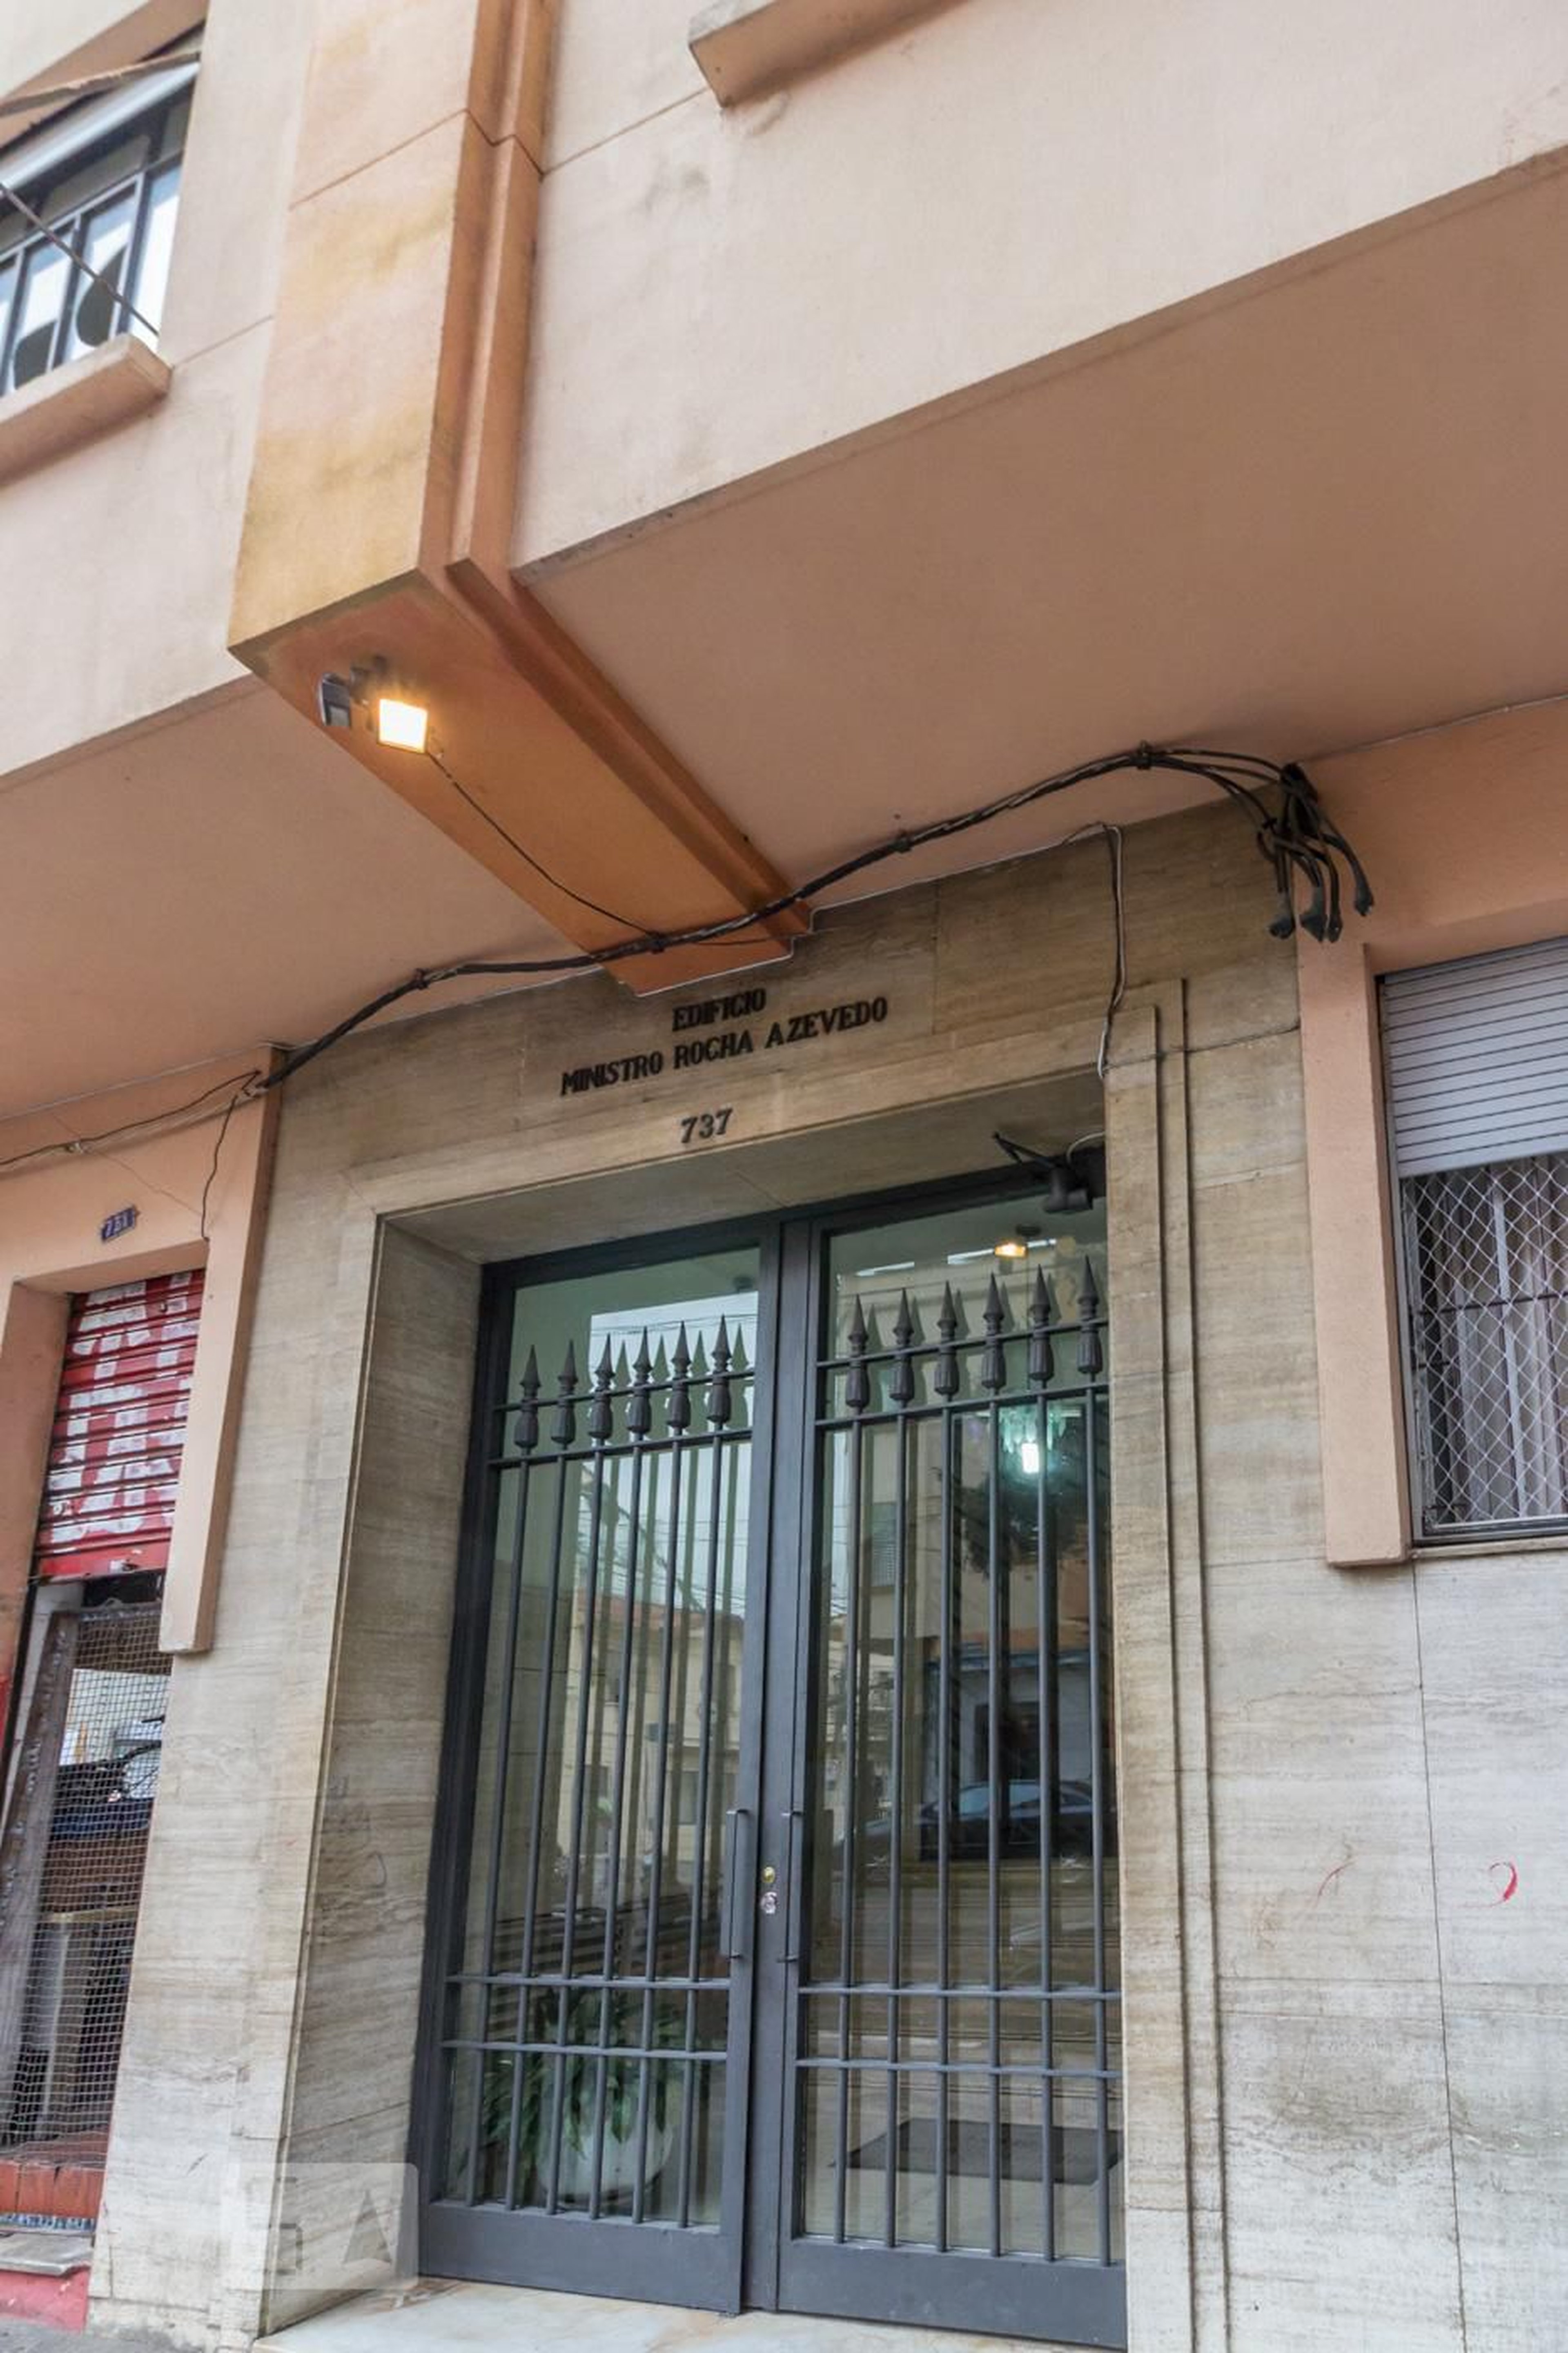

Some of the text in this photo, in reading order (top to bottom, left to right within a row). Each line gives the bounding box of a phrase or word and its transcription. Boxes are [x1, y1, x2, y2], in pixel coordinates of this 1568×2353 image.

[672, 988, 766, 1032] EDIFICIO
[560, 996, 888, 1096] MINISTRO ROCHA AZEVEDO
[681, 1108, 733, 1143] 737
